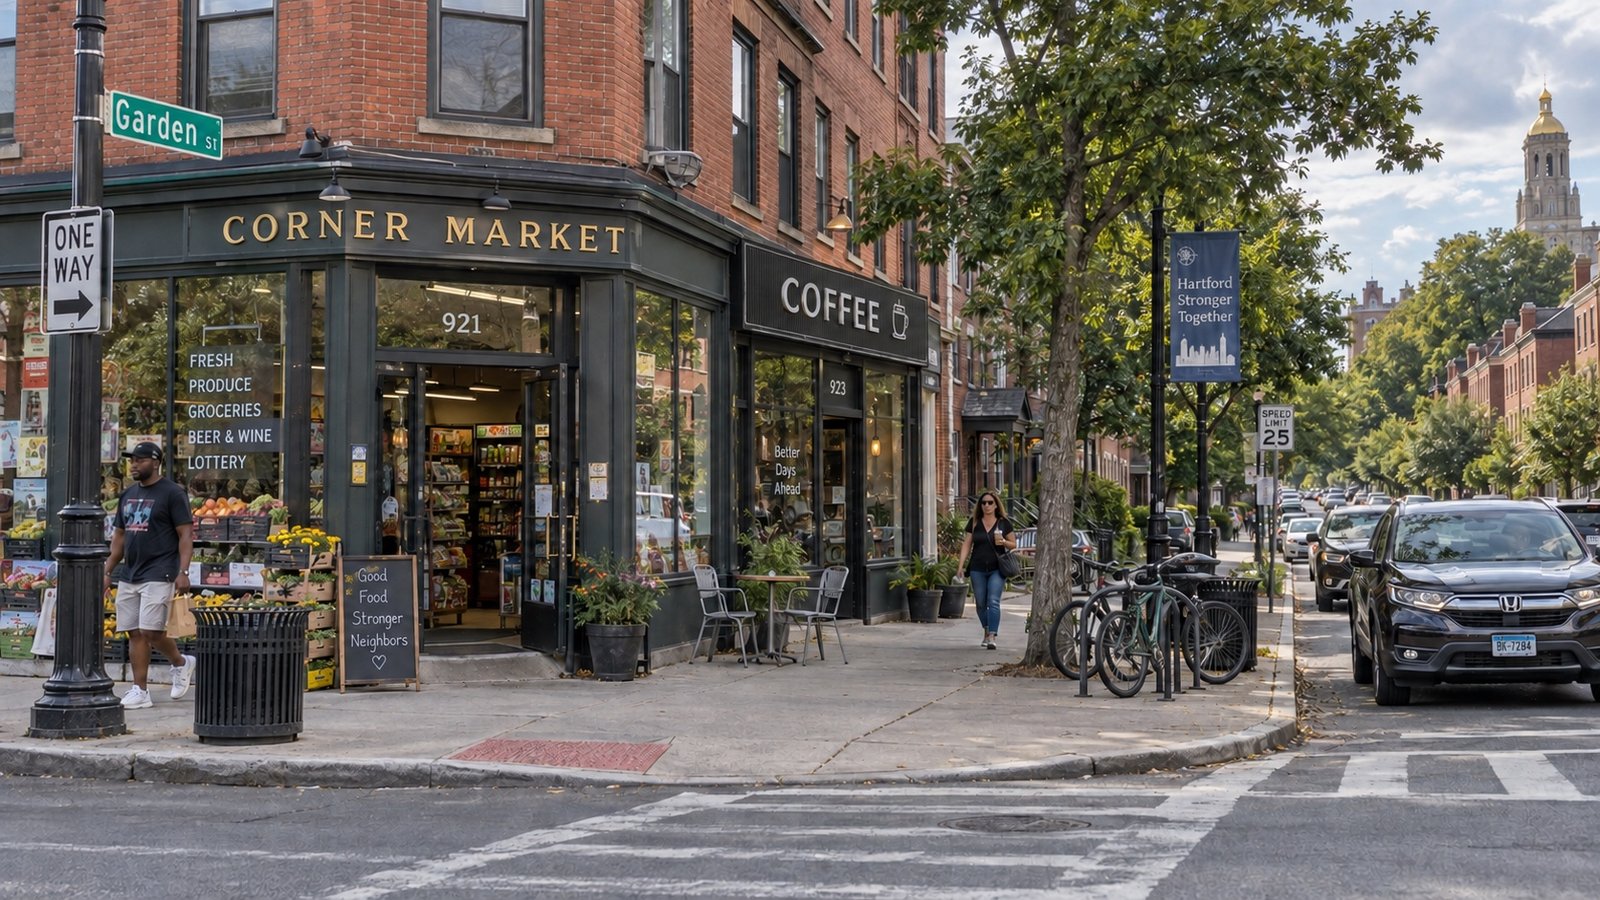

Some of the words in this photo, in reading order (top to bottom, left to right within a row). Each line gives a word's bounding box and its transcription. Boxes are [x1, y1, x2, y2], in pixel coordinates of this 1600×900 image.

[116, 99, 197, 146] Garden
[54, 222, 94, 251] ONE
[222, 209, 410, 245] CORNER
[445, 215, 625, 254] MARKET
[54, 255, 95, 283] WAY
[1178, 276, 1232, 289] Hartford
[781, 277, 880, 333] COFFEE
[1178, 294, 1232, 307] Stronger
[442, 312, 482, 334] 921
[1178, 310, 1232, 325] Together
[189, 353, 234, 368] FRESH
[189, 377, 251, 393] PRODUCE
[830, 380, 846, 395] 923
[188, 403, 261, 418] GROCERIES
[1265, 419, 1288, 427] LIMIT
[188, 430, 220, 443] BEER
[225, 429, 234, 443] &
[238, 428, 272, 443] WINE
[1263, 429, 1289, 445] 25
[774, 445, 800, 458] Better
[188, 455, 246, 469] LOTTERY
[775, 463, 796, 478] Days
[774, 482, 800, 494] Ahead
[358, 567, 387, 582] Good
[359, 589, 388, 603] Food
[352, 611, 403, 630] Stronger
[351, 633, 408, 653] Neighbors
